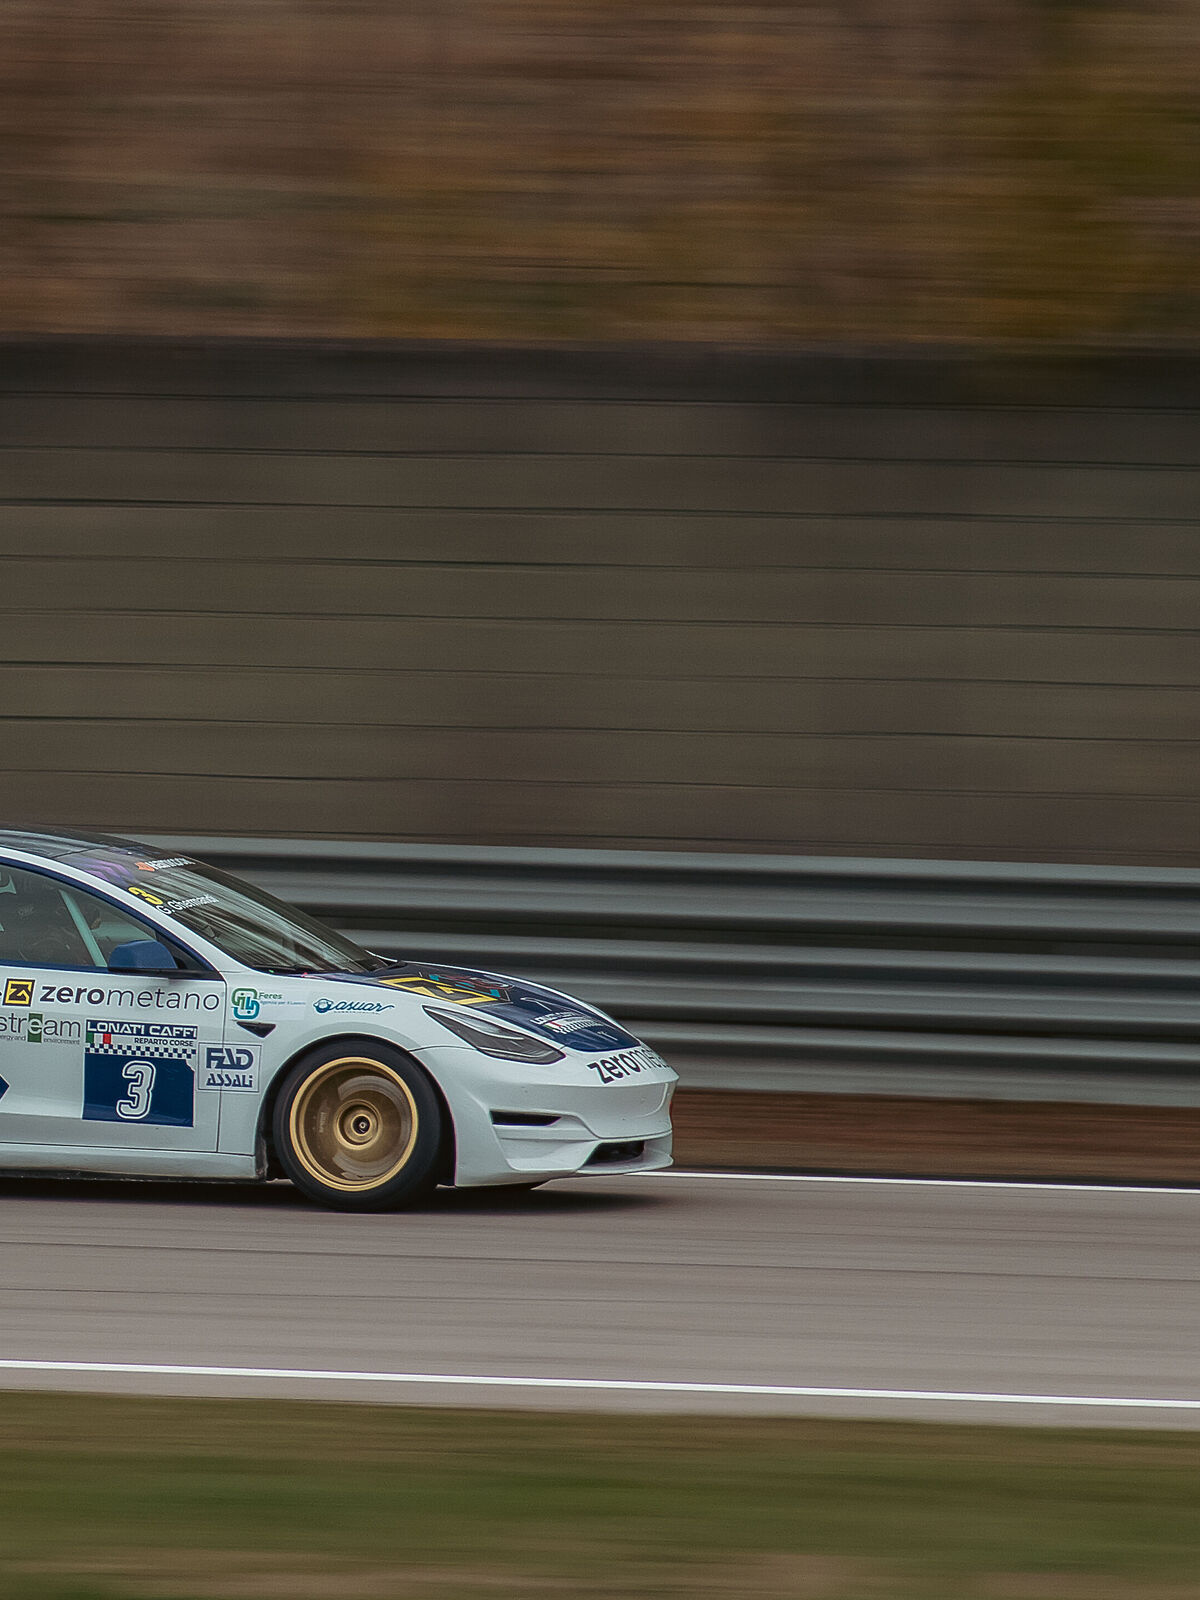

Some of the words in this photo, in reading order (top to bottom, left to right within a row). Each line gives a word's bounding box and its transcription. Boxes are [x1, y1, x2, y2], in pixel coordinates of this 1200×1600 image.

[128, 886, 163, 905] 3
[39, 985, 220, 1011] zerometano
[259, 992, 283, 1000] Feres
[87, 1021, 145, 1035] LONATI
[149, 1025, 197, 1038] CAFFI
[134, 1037, 168, 1046] REPARTO
[169, 1039, 194, 1047] CORSE
[206, 1047, 253, 1070] FAD
[116, 1060, 156, 1119] 3
